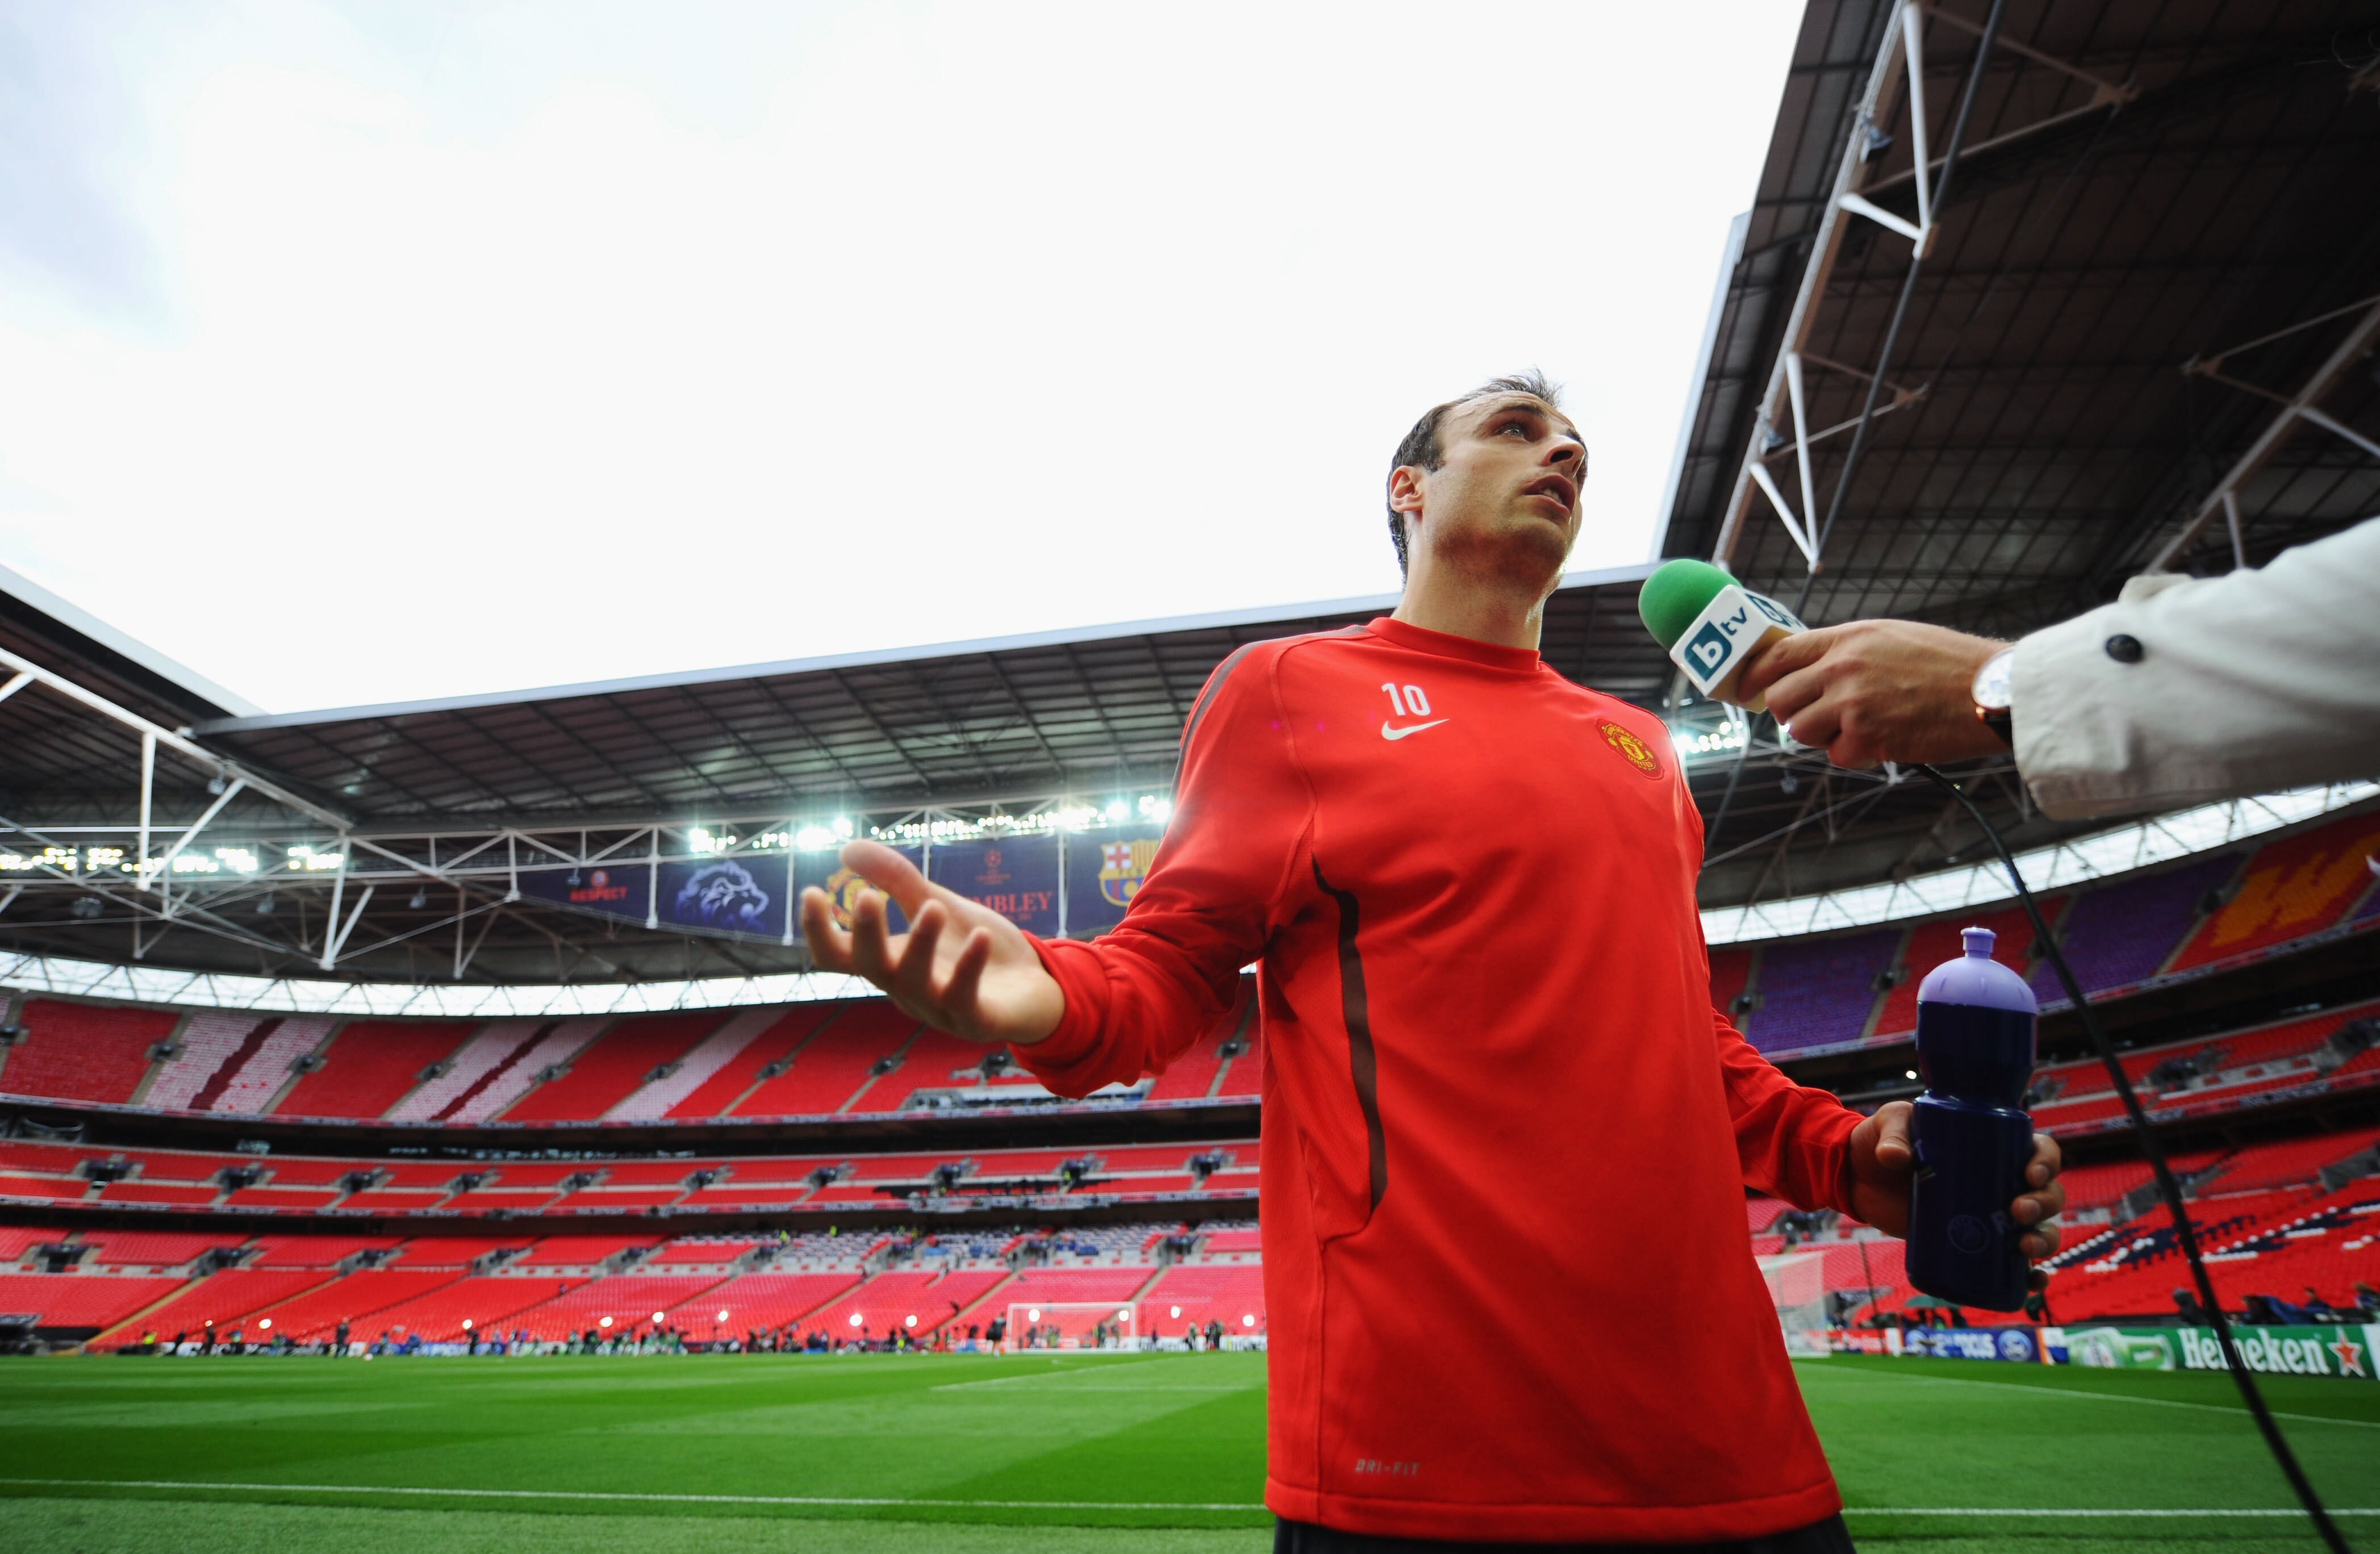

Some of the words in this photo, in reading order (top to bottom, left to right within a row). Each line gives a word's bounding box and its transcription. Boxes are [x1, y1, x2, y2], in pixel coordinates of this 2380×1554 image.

[1692, 606, 1747, 669] btv
[1381, 683, 1431, 716] 10
[570, 886, 627, 902] RESPECT
[970, 891, 1054, 913] MBLEY
